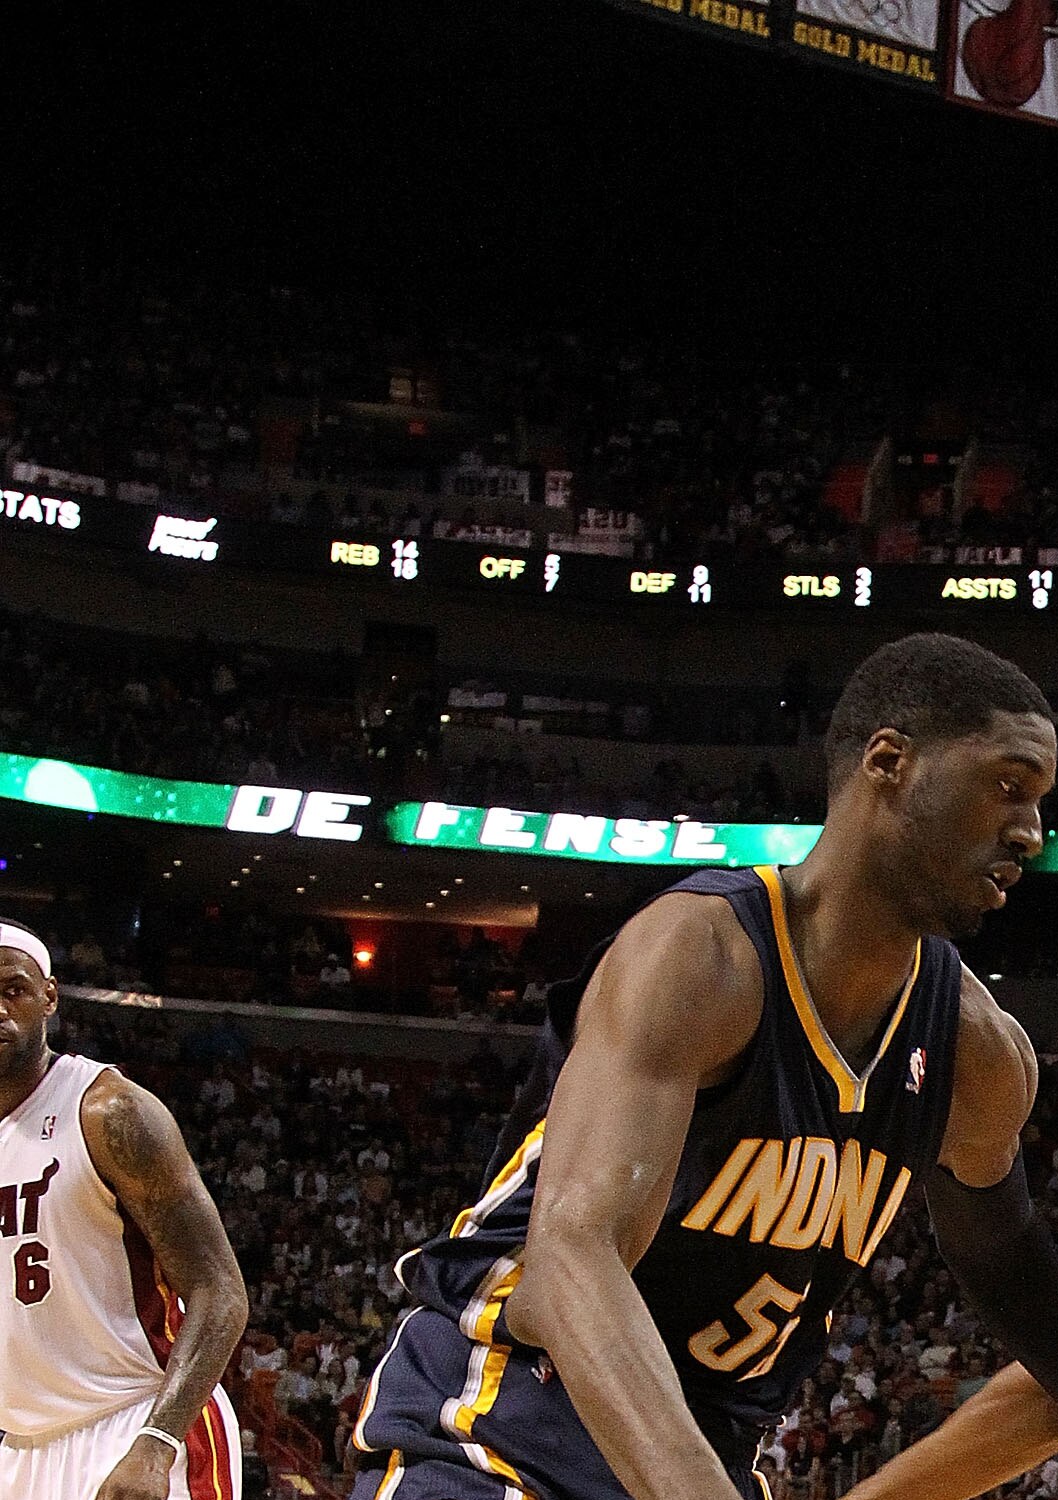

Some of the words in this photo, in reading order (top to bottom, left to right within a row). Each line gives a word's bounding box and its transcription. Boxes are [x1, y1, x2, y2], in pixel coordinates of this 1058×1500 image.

[793, 21, 851, 58] GOLD
[856, 39, 936, 82] MEDAL
[0, 490, 81, 529] TATS
[331, 541, 380, 567] REB
[392, 539, 419, 559] 14
[479, 556, 527, 580] OFF
[391, 558, 418, 580] 18
[630, 571, 677, 594] DEF
[693, 564, 710, 586] 9
[783, 575, 841, 598] STLS
[855, 566, 872, 587] 3
[687, 583, 712, 604] 11
[854, 585, 872, 607] 2
[941, 577, 1018, 600] ASSTS
[1028, 569, 1053, 590] 11
[226, 784, 372, 842] DE
[414, 801, 728, 860] FENSE
[14, 1239, 52, 1307] 6
